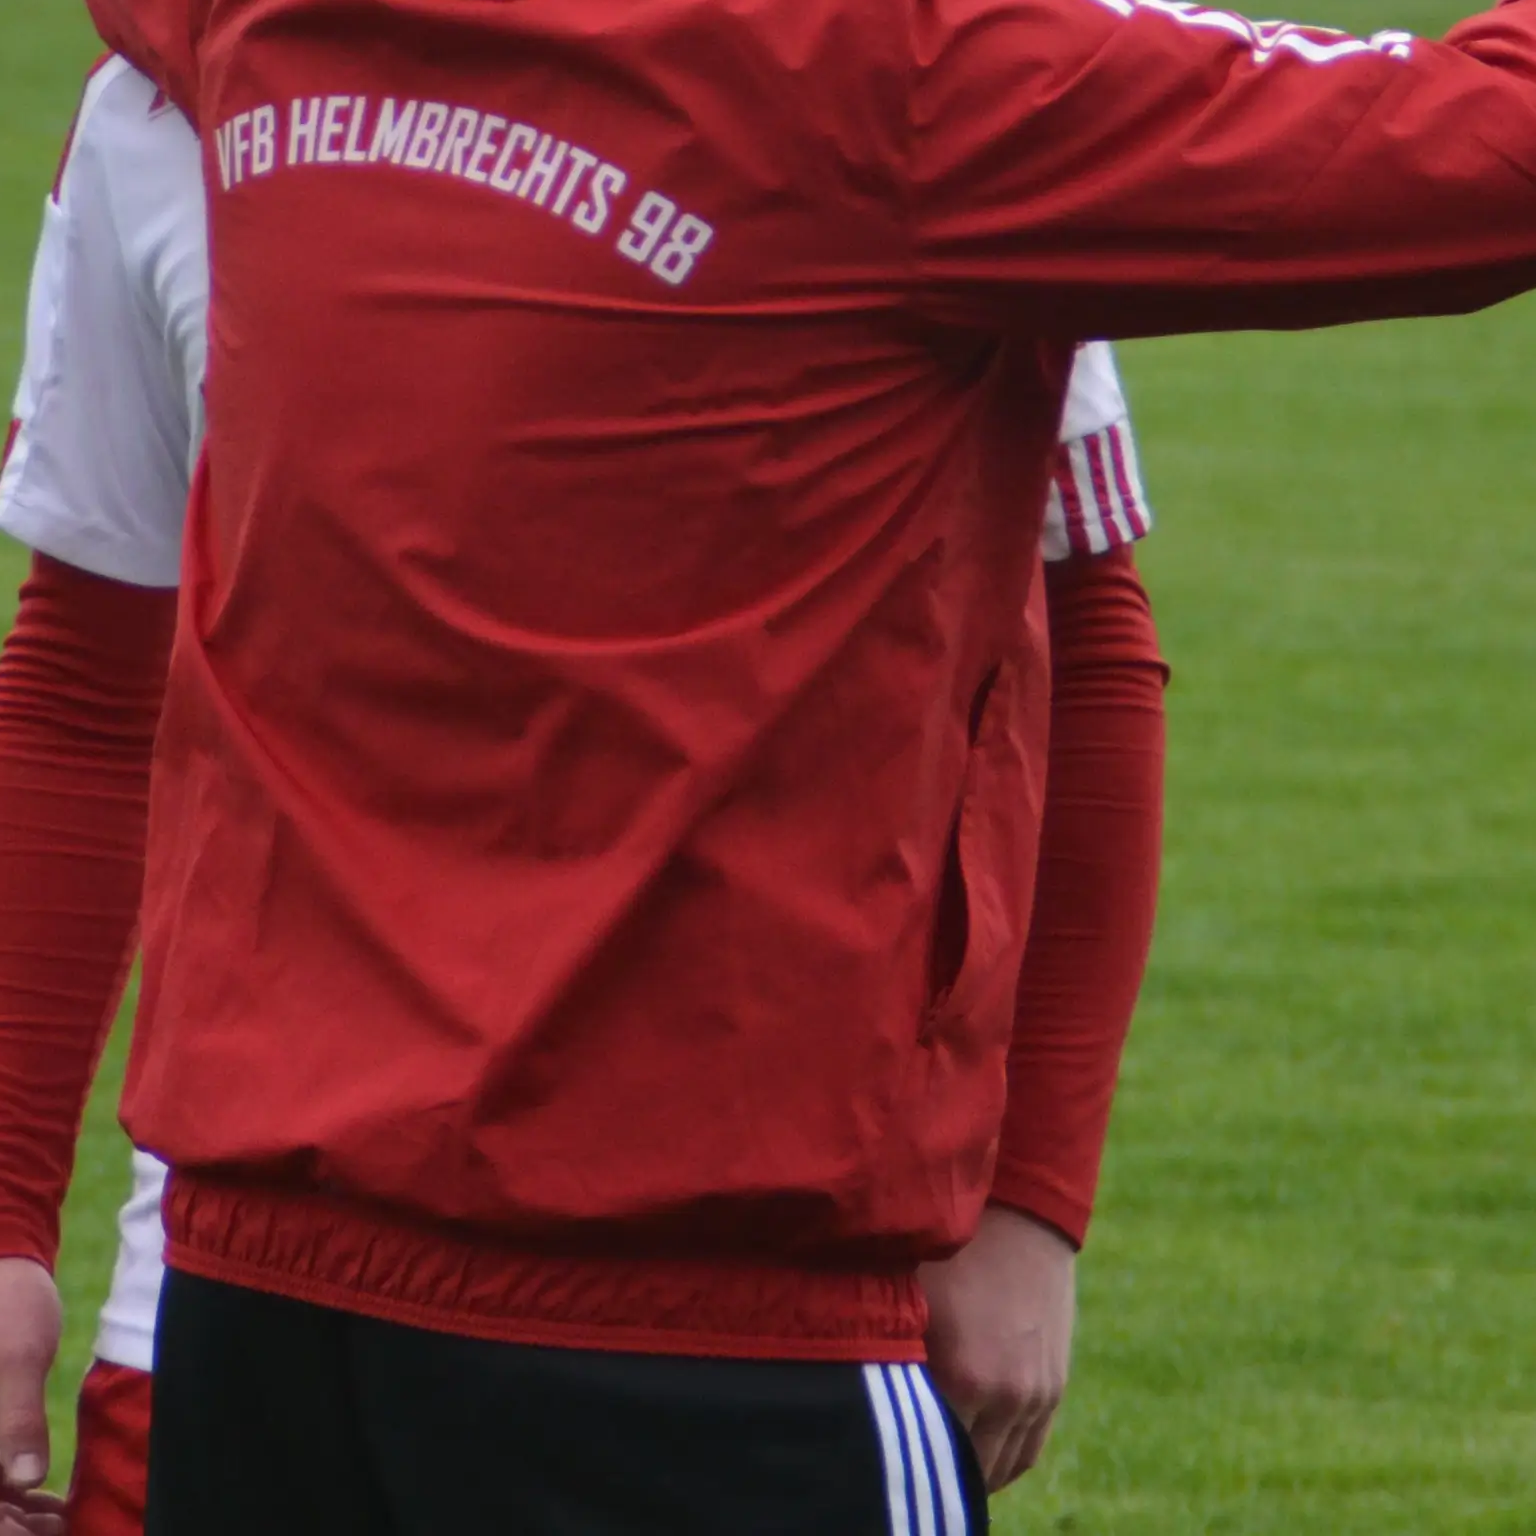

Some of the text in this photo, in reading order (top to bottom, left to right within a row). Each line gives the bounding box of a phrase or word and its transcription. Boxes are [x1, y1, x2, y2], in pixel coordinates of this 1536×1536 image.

[214, 95, 715, 285] VFB HELMBRECHTS 98
